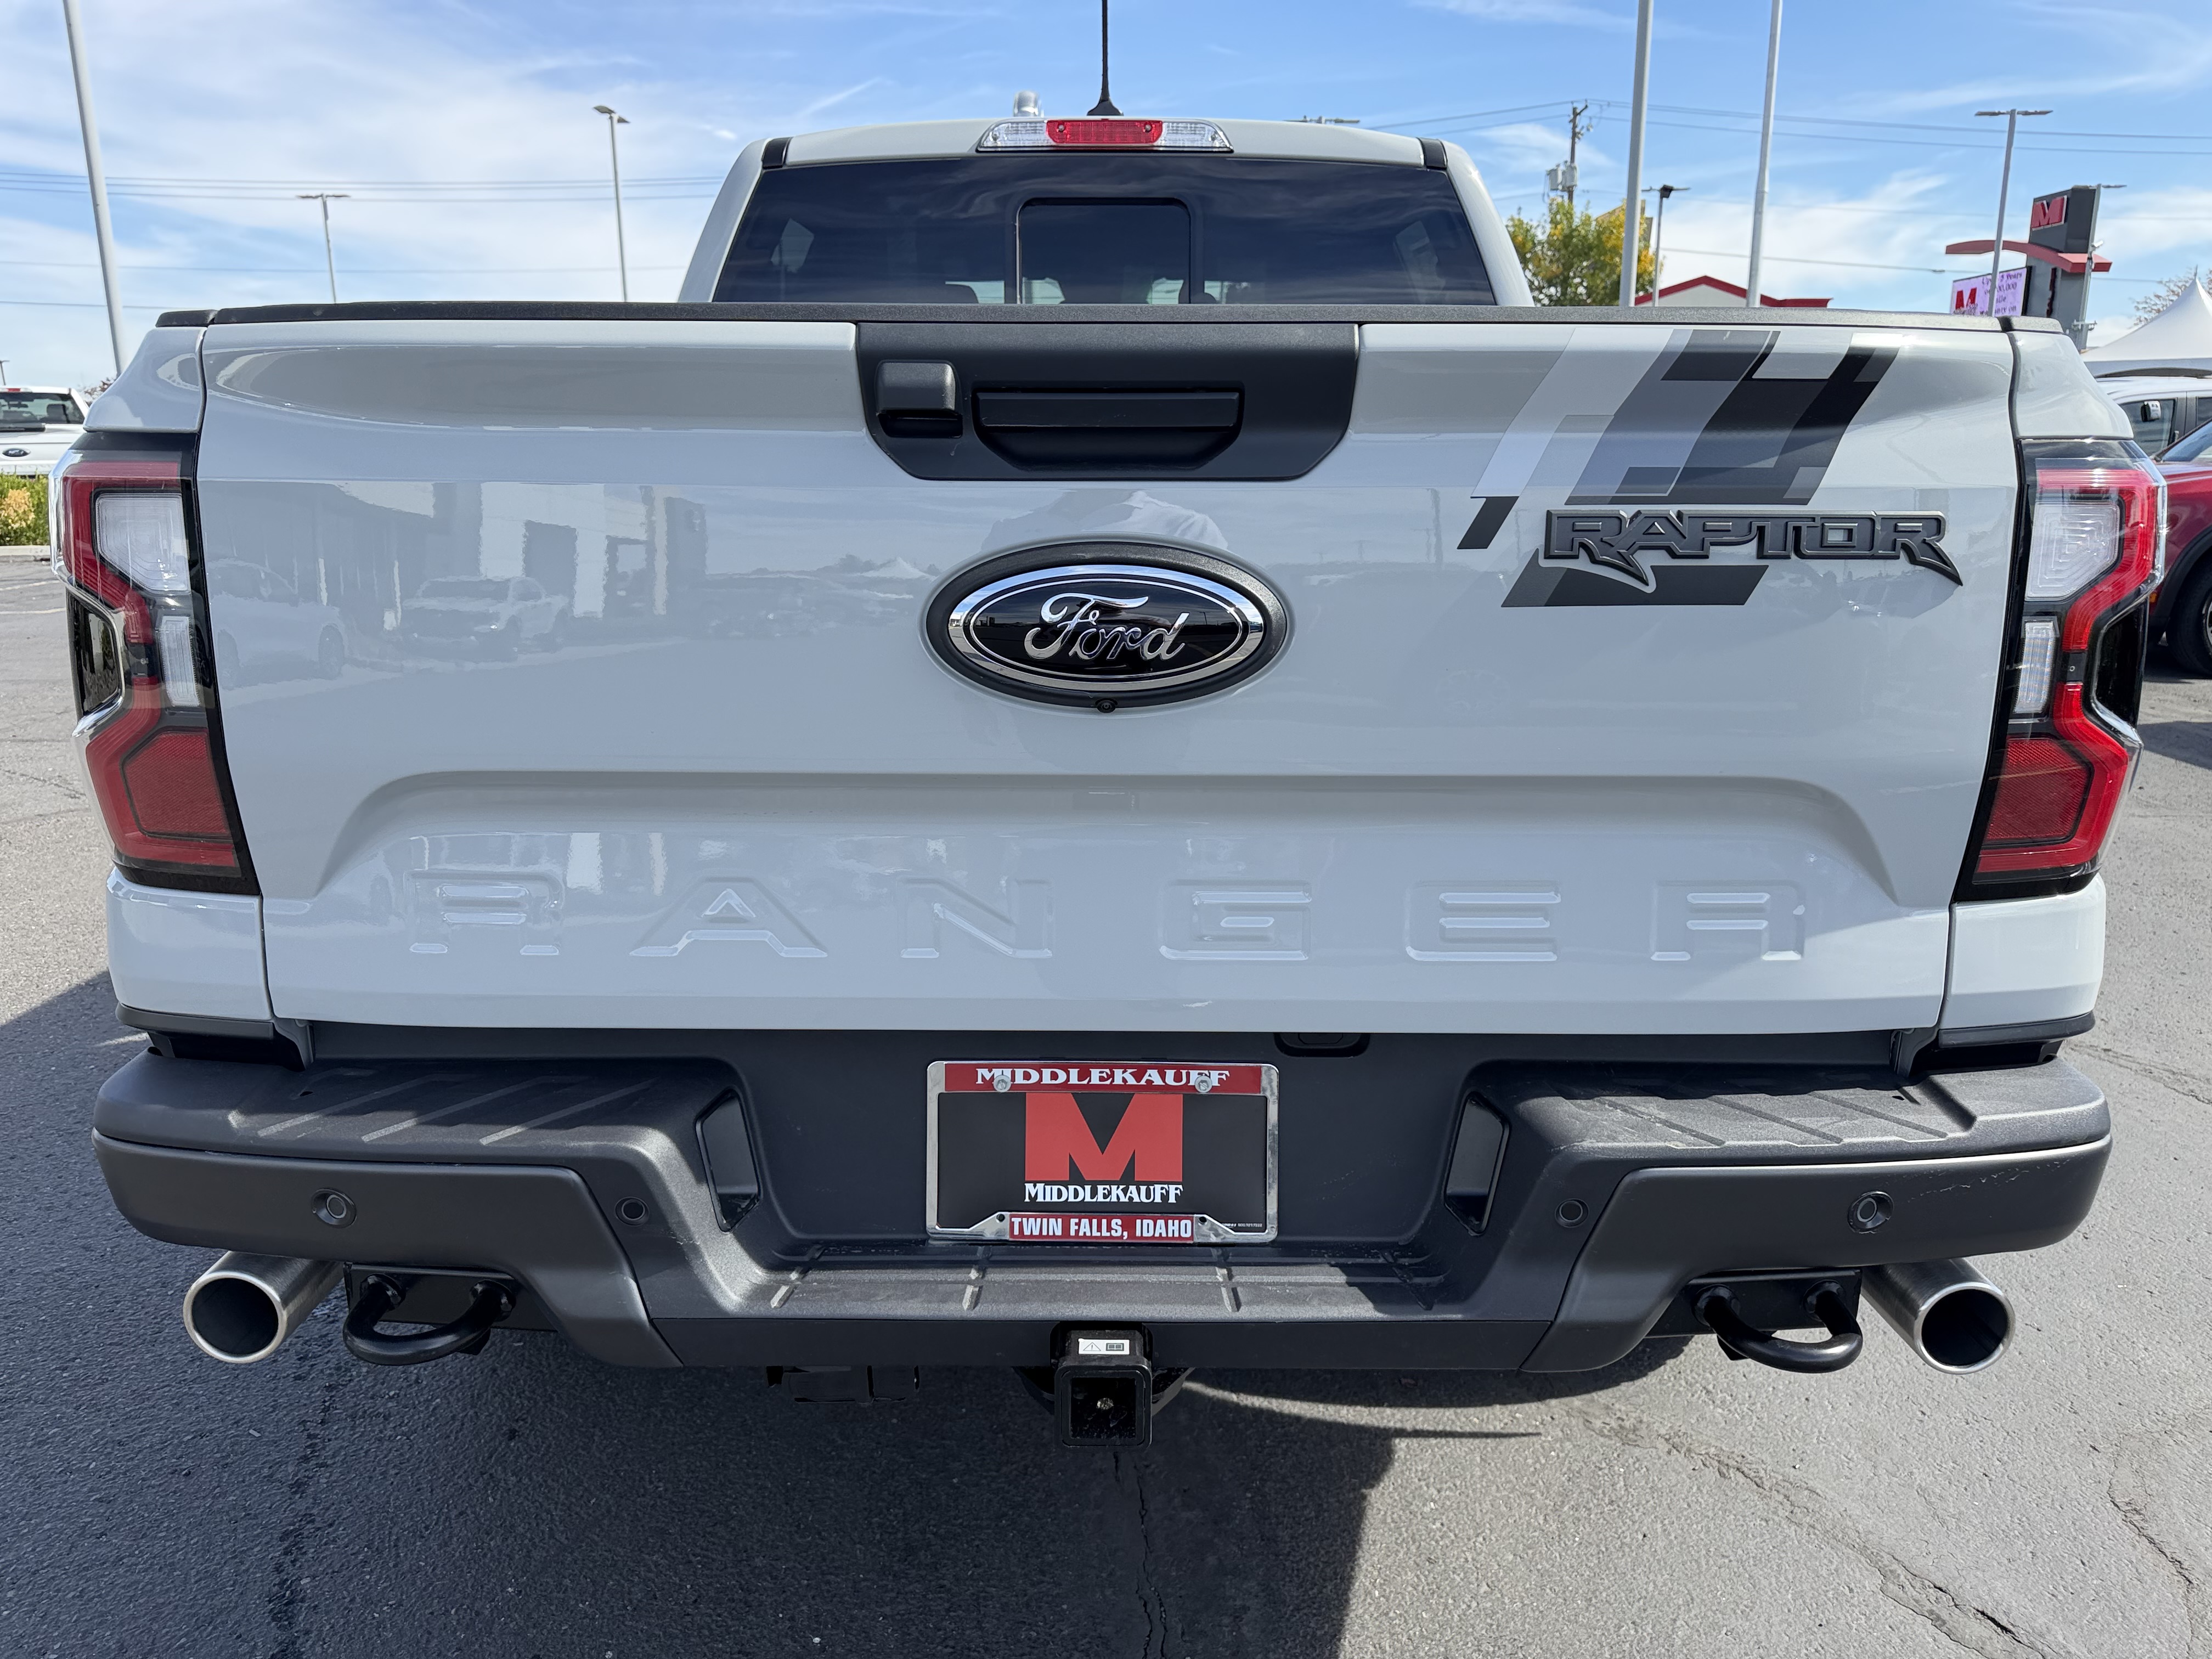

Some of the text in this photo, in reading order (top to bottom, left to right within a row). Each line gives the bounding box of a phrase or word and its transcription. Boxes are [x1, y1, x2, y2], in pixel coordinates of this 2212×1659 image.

[2031, 195, 2067, 230] M
[1544, 509, 1963, 586] RAPTOR
[1024, 592, 1189, 661] Ford
[405, 871, 1807, 961] RANGER
[1025, 1092, 1183, 1182] M
[1024, 1183, 1184, 1203] MIDDLEKAUFF
[1011, 1217, 1192, 1239] TWIN FALLS, IDAHO
